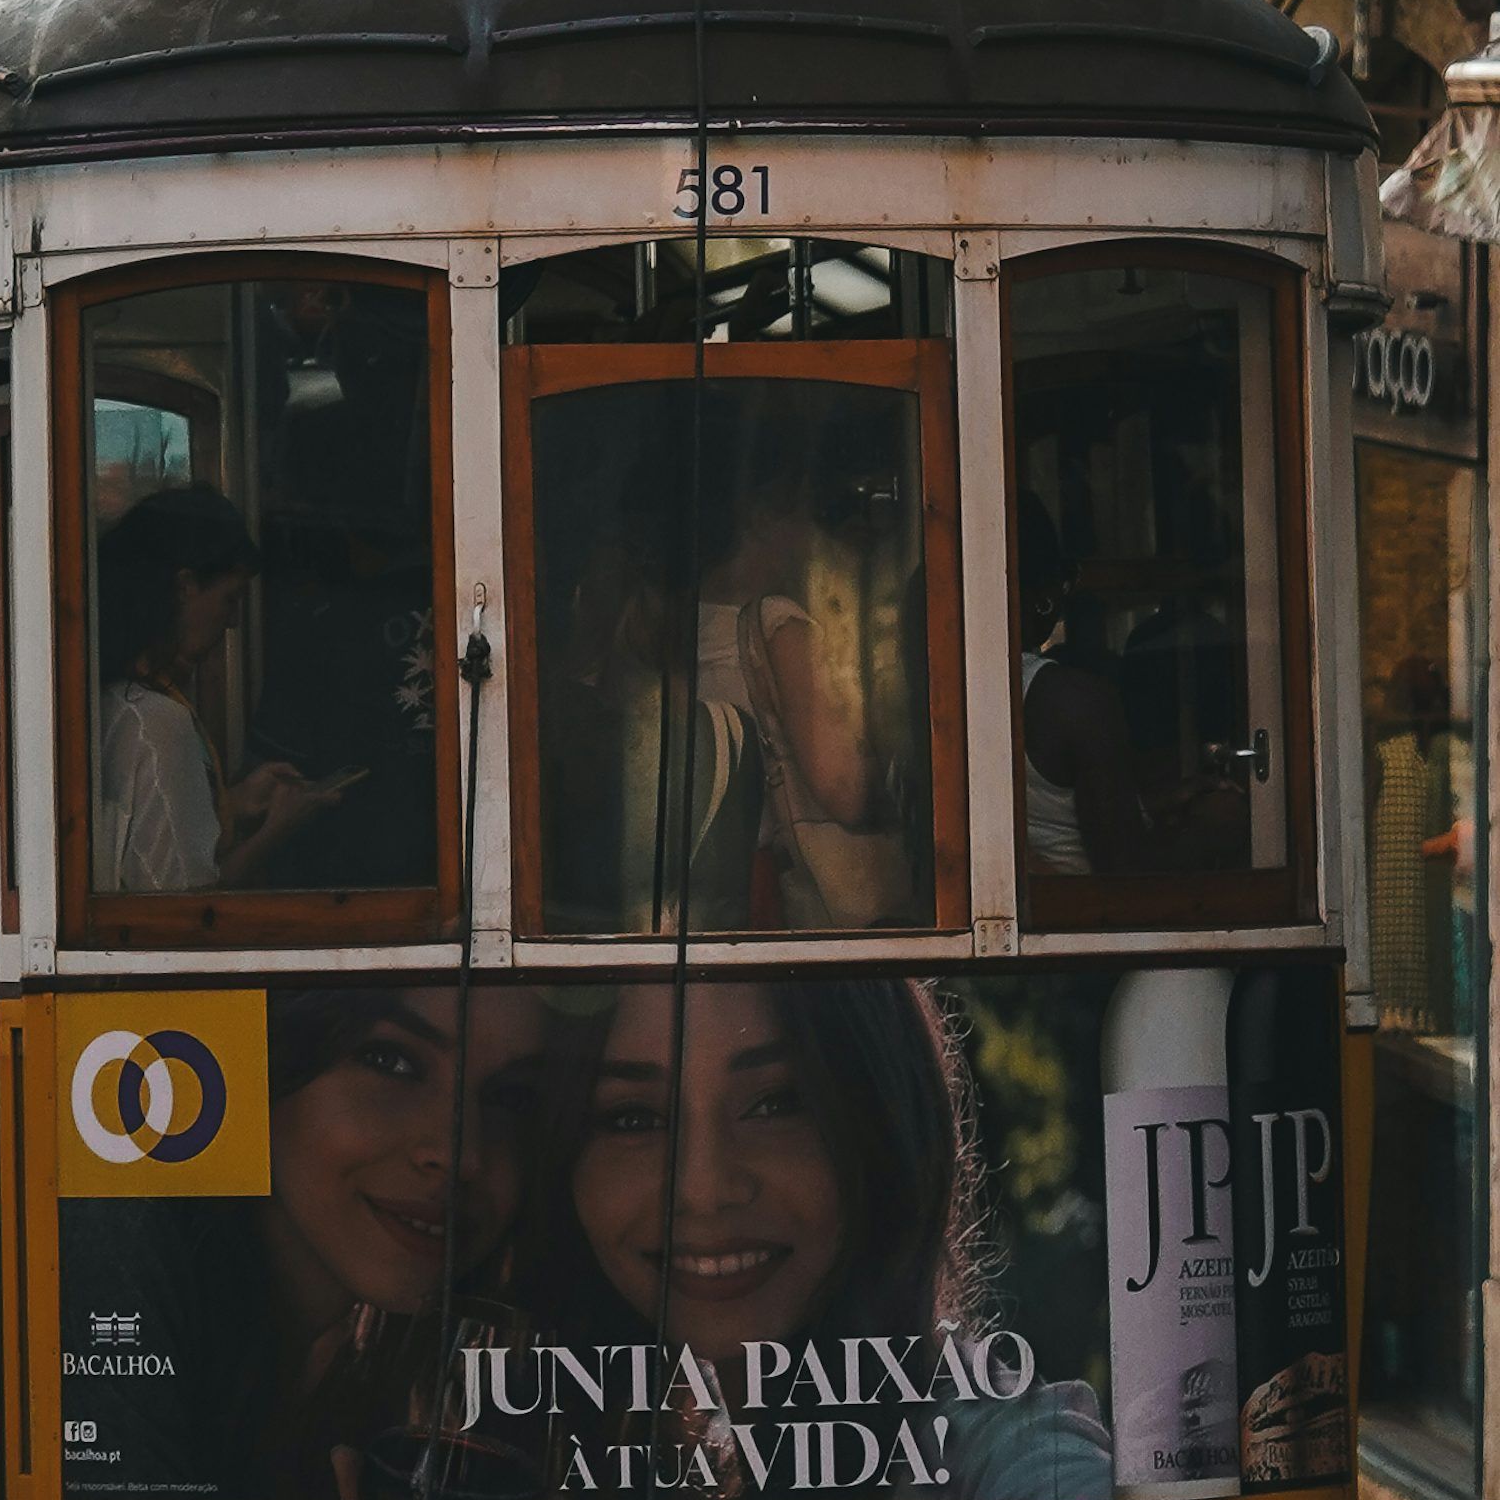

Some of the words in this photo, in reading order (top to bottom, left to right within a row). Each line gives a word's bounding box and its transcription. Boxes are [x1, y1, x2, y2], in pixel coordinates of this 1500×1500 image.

[672, 164, 770, 219] 581
[1126, 1118, 1232, 1292] JP
[1248, 1108, 1331, 1288] JP
[457, 1342, 720, 1432] JUNTA
[740, 1319, 1035, 1410] PAIXÃO
[64, 1447, 122, 1464] bacalhoa.pt
[558, 1434, 599, 1491] À
[605, 1443, 719, 1491] TUA
[730, 1415, 951, 1492] VIDA!
